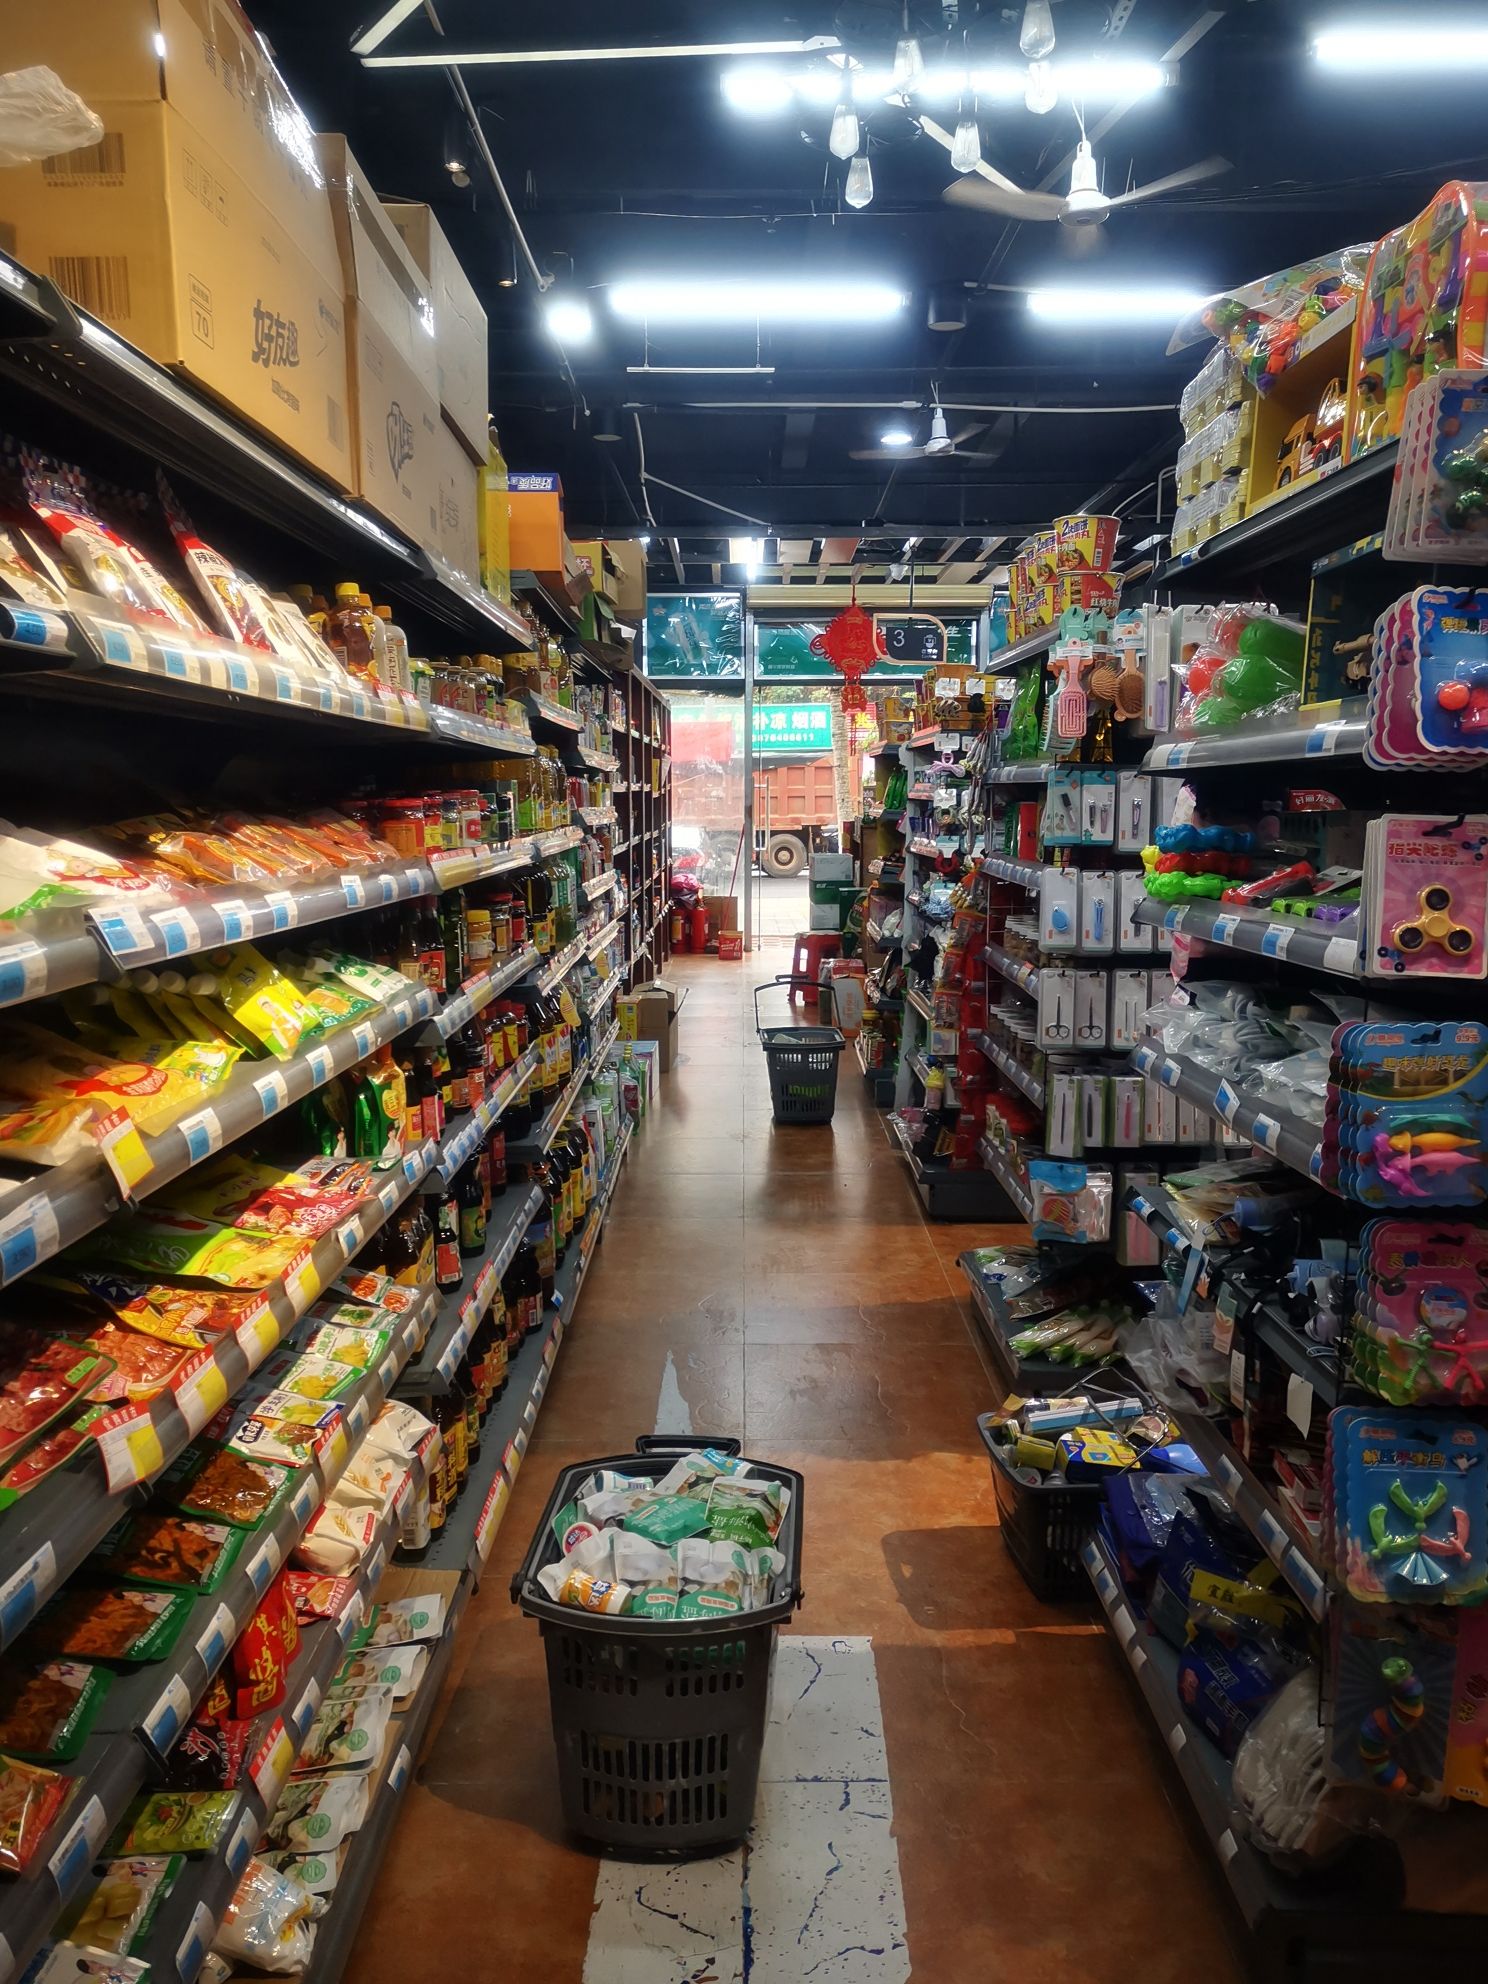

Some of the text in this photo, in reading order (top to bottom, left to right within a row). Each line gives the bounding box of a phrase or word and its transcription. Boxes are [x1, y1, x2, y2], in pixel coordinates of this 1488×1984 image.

[194, 311, 209, 338] 70
[251, 299, 299, 368] 好友趣
[893, 629, 905, 647] 3
